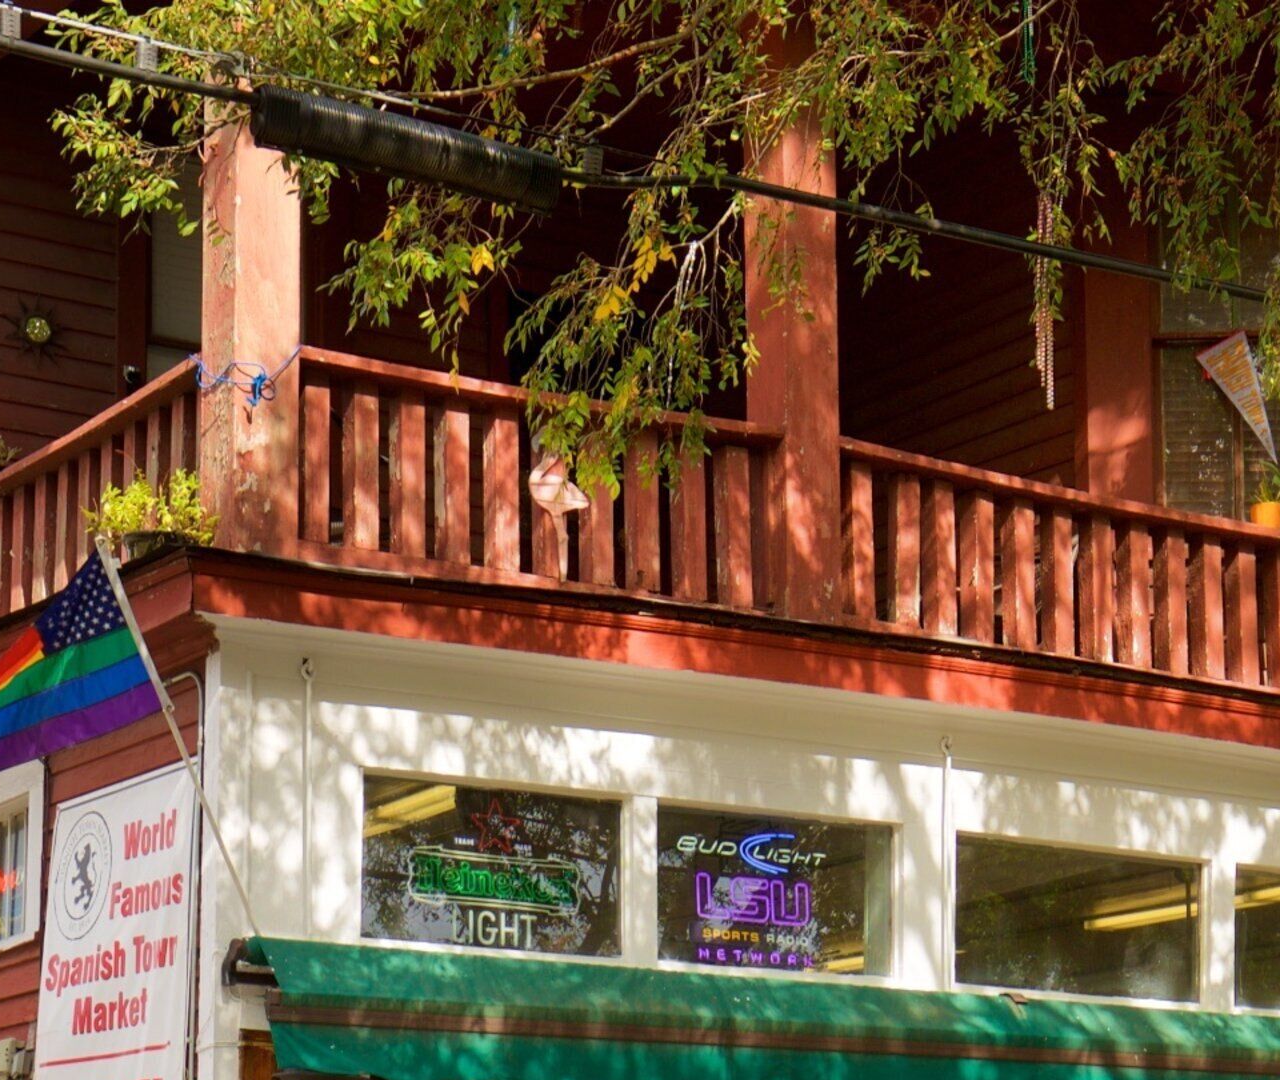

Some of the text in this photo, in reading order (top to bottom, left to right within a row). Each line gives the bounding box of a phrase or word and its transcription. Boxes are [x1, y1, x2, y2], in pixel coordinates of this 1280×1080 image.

[124, 808, 177, 860] World
[676, 835, 827, 866] BUD LIGHT
[109, 872, 184, 920] Famous
[416, 853, 576, 909] Heineken
[695, 872, 810, 926] LSU
[452, 908, 538, 950] LIGHT
[702, 927, 809, 947] SPORTS RADIO
[45, 940, 126, 997] Spanish
[698, 947, 815, 967] NETWORK
[72, 987, 148, 1036] Market
